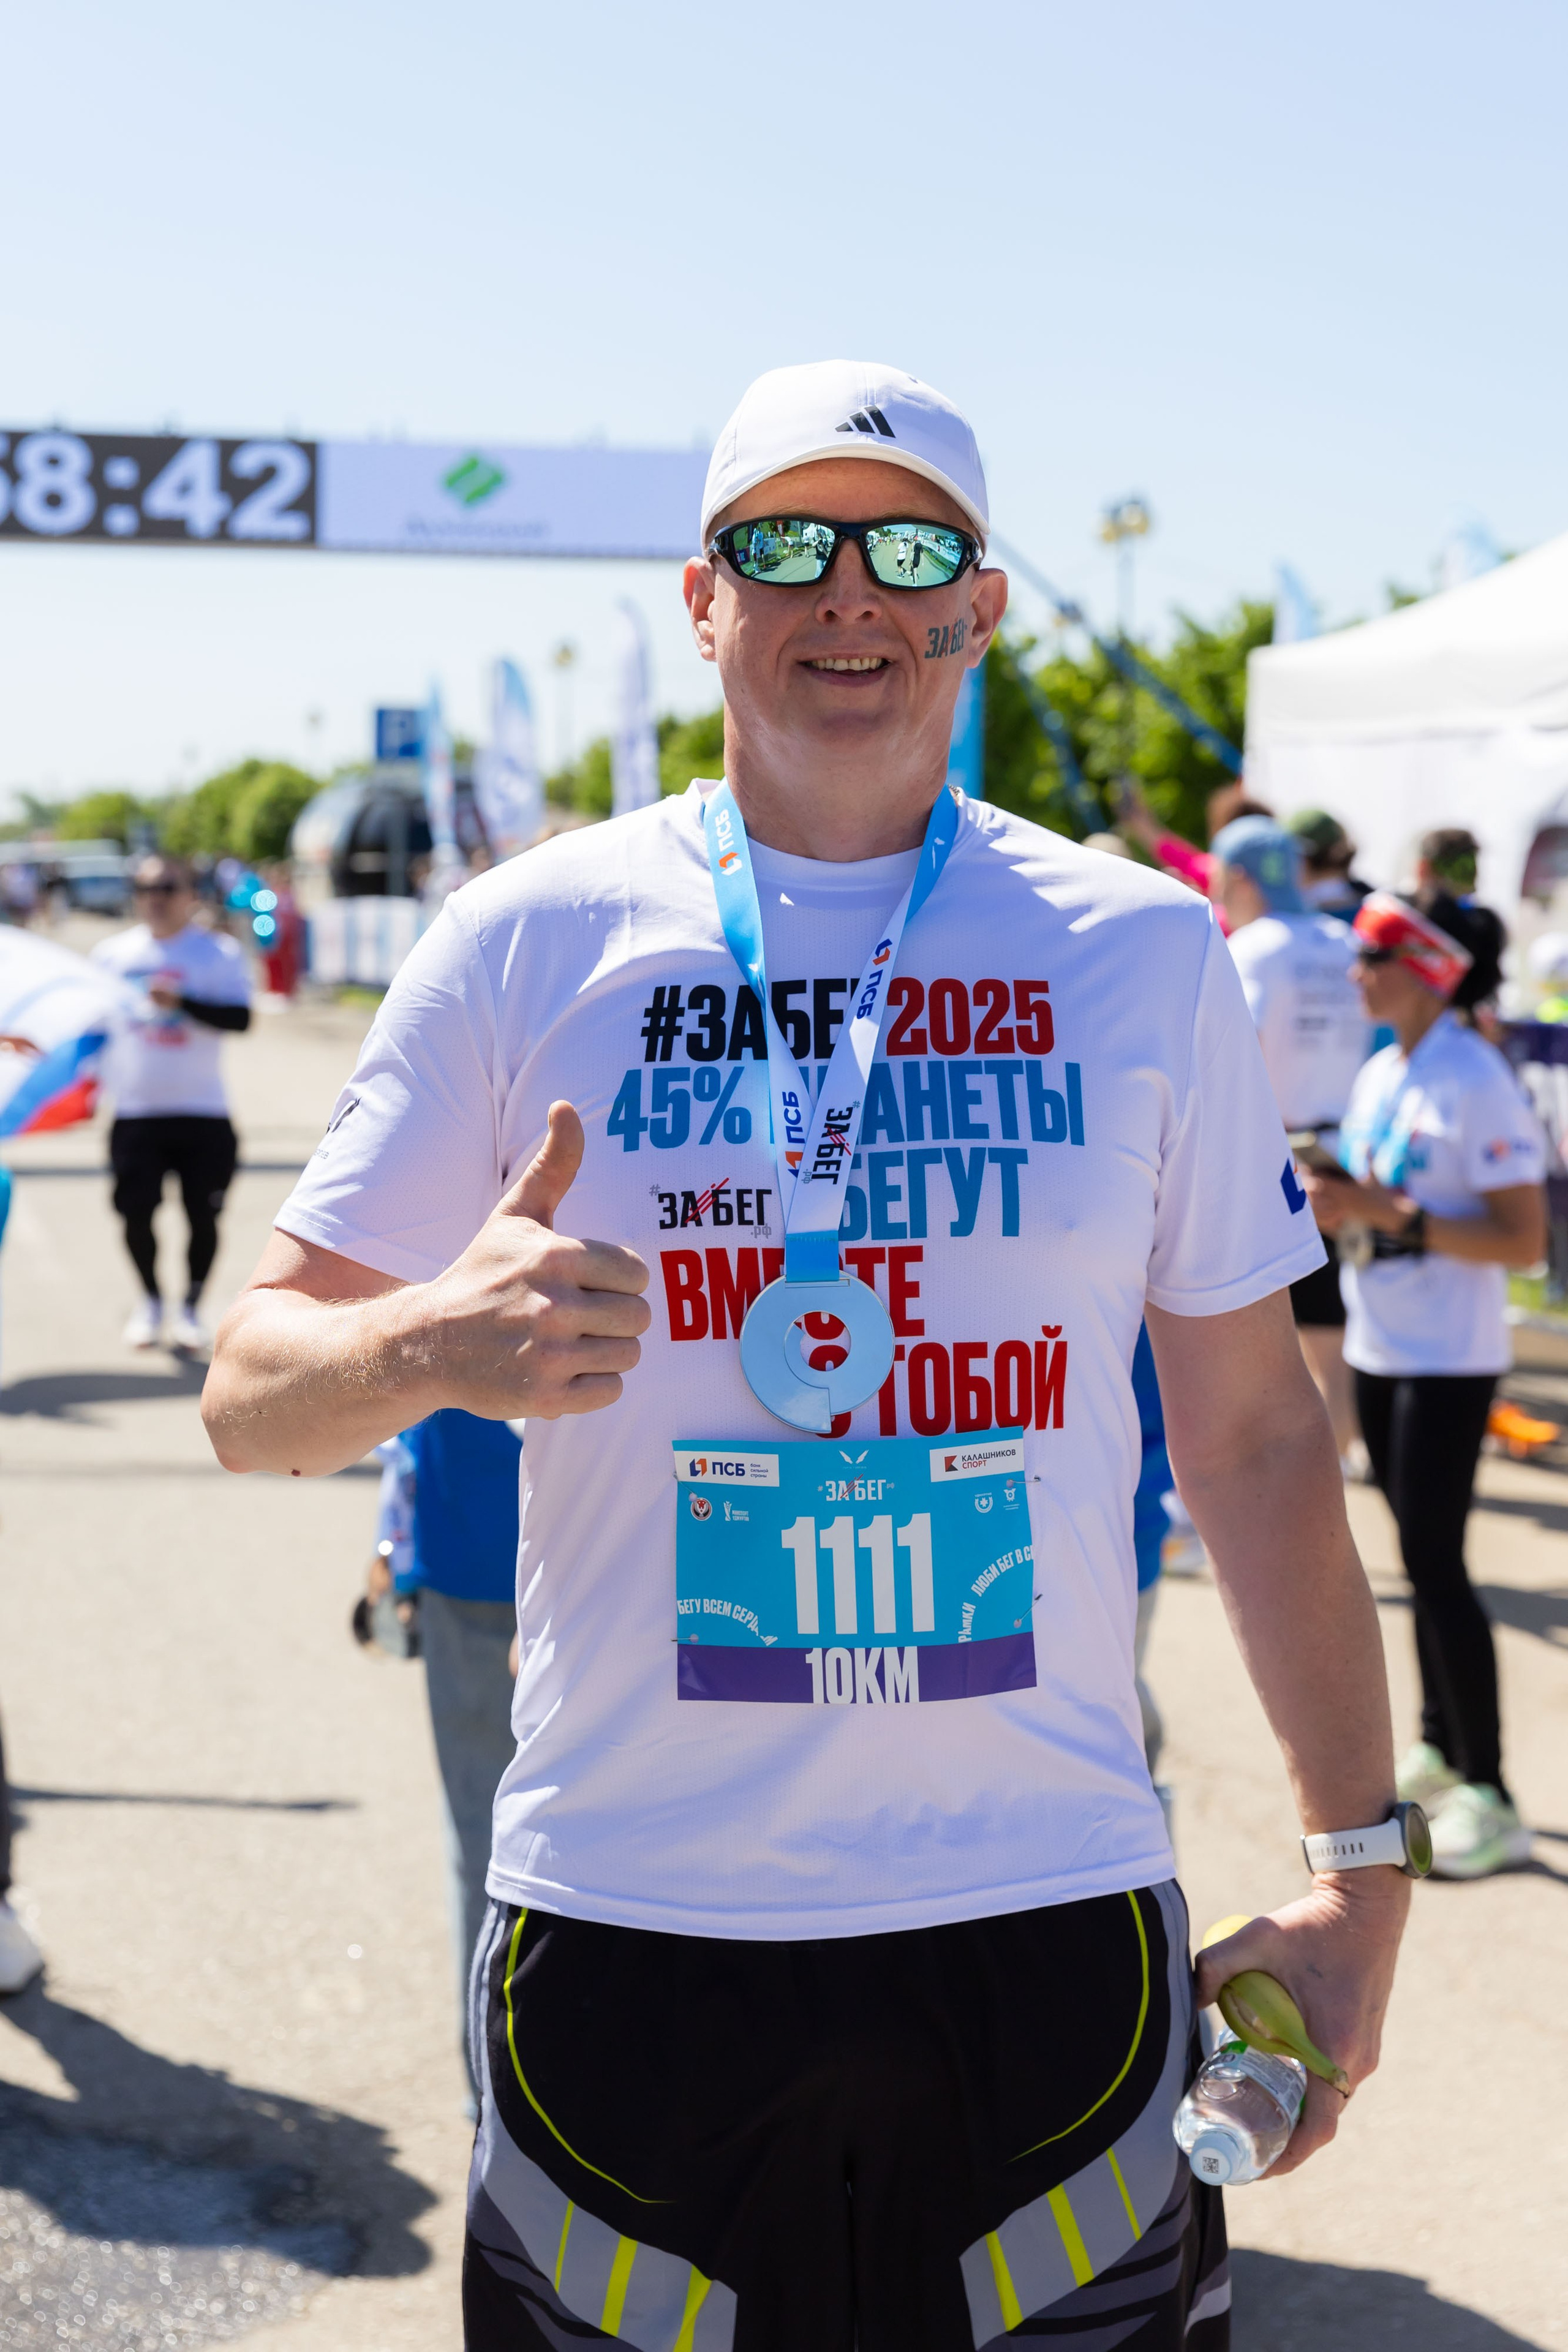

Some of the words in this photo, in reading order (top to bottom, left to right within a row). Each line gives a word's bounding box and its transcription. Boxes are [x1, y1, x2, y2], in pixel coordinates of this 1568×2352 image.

[0, 431, 312, 540] 8:42
[715, 809, 734, 852] ПСБ
[856, 969, 883, 1019] ПСБ
[606, 1066, 752, 1152] 45%
[770, 1060, 1085, 1147] АНЕТЫ
[782, 1091, 805, 1144] ПСБ
[660, 1246, 925, 1341] ВМТЕ
[712, 1462, 745, 1477] ПСБ
[962, 1449, 1016, 1461] КАЛАШНИКОВ
[962, 1460, 987, 1469] СПОРТ
[781, 1512, 935, 1634] 1111
[971, 1563, 1000, 1597] ЛЮБИ
[996, 1552, 1014, 1573] БЕГ
[1015, 1548, 1023, 1564] В
[677, 1599, 701, 1615] БЕГУ
[703, 1599, 732, 1617] ВСЕМ
[958, 1602, 976, 1643] РАМКИ
